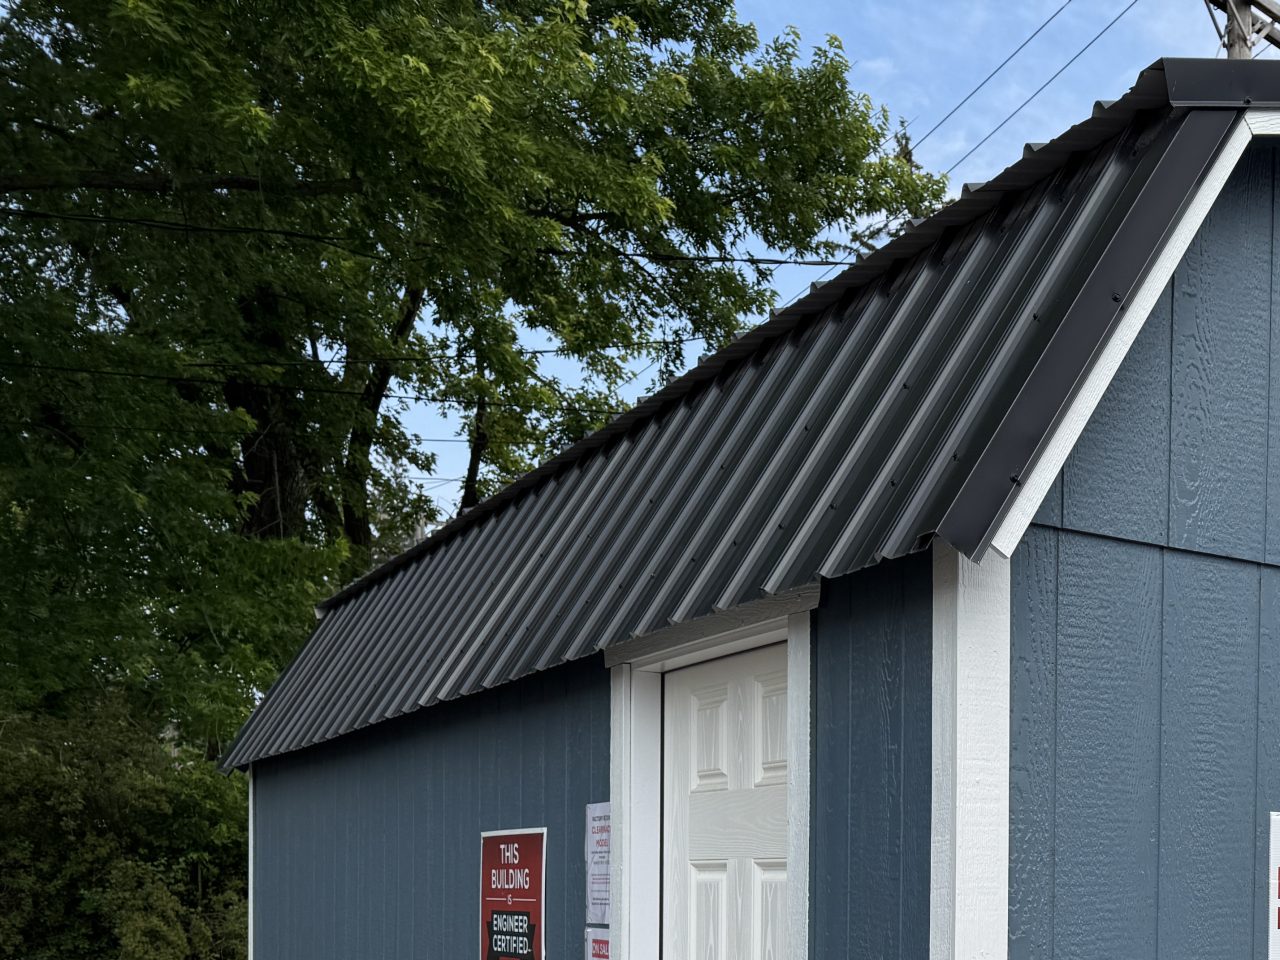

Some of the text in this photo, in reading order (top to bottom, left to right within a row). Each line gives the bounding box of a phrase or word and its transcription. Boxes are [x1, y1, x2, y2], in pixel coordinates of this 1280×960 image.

[500, 843, 520, 864] THIS
[491, 868, 530, 890] BUILDING
[493, 914, 528, 933] ENGINEER
[492, 934, 529, 954] CERTIFIED
[600, 943, 608, 956] SAL
